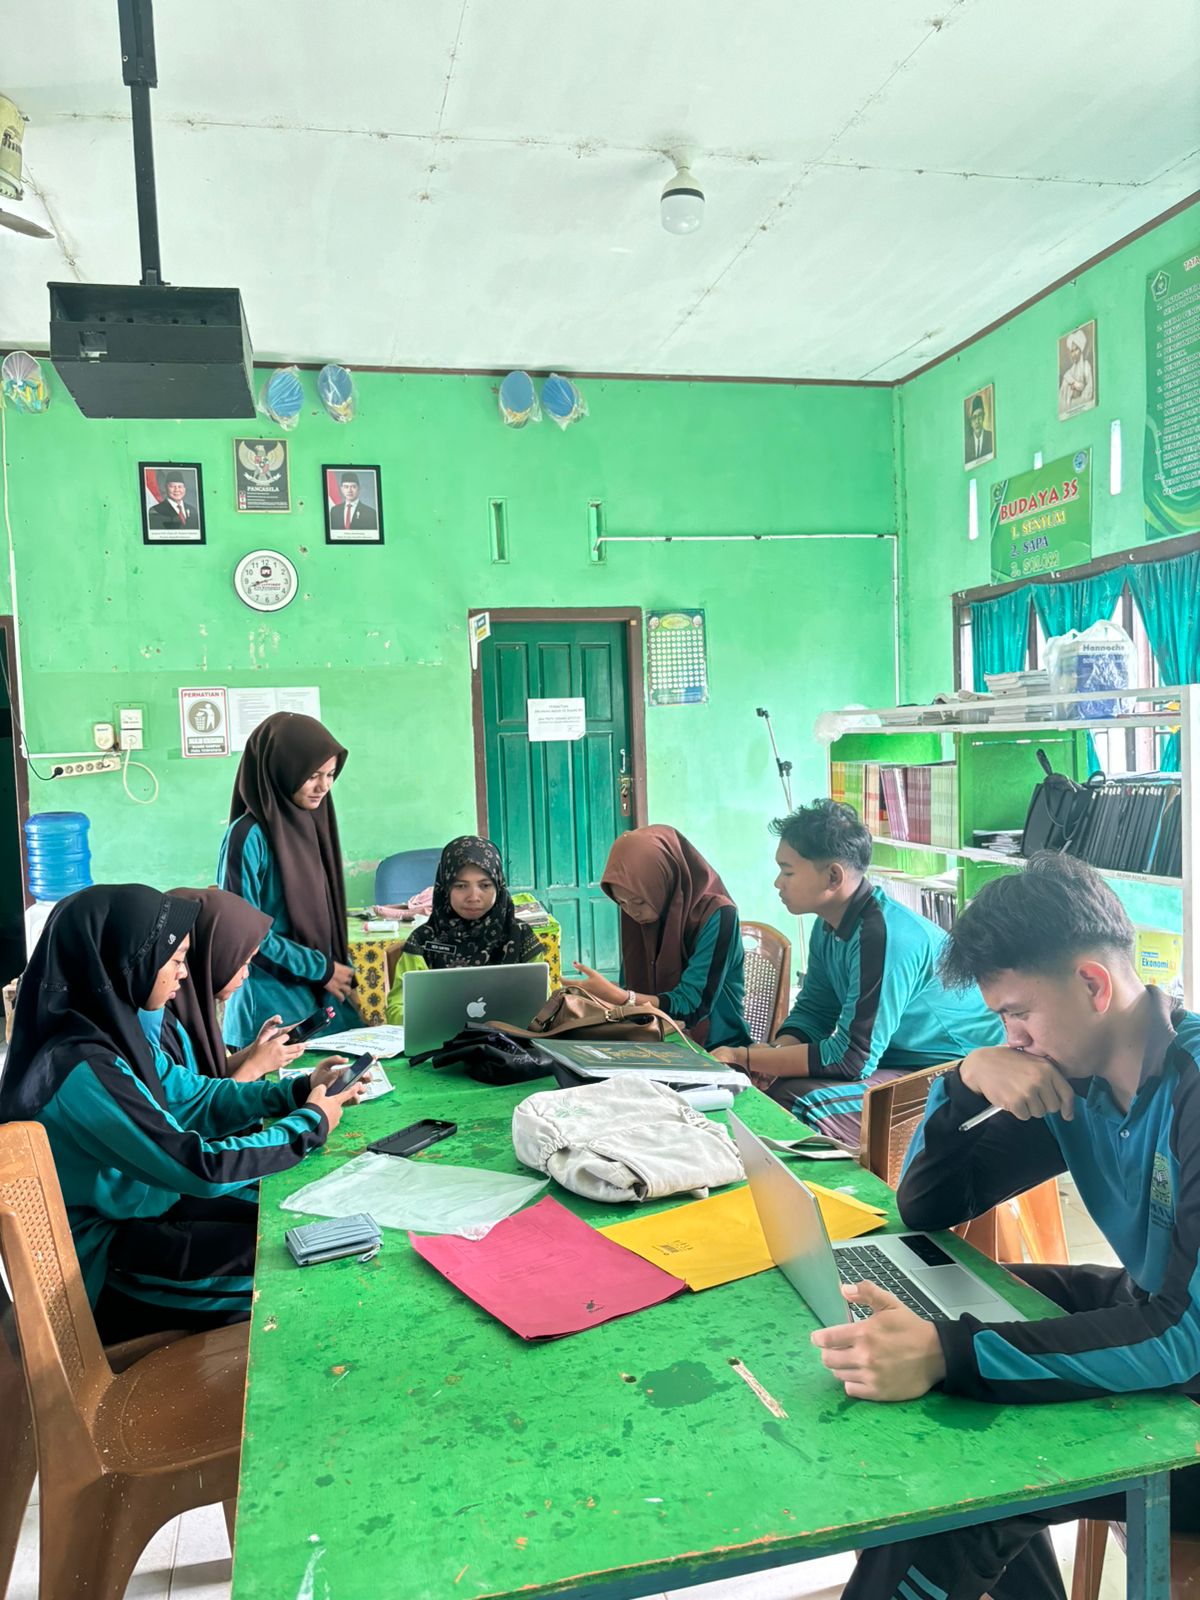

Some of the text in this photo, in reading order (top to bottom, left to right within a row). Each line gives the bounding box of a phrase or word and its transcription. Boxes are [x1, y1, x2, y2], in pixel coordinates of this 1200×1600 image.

[1000, 479, 1078, 521] BUDAYA 3S
[1023, 536, 1049, 554] SAPA
[1141, 957, 1168, 968] Ekonomi
